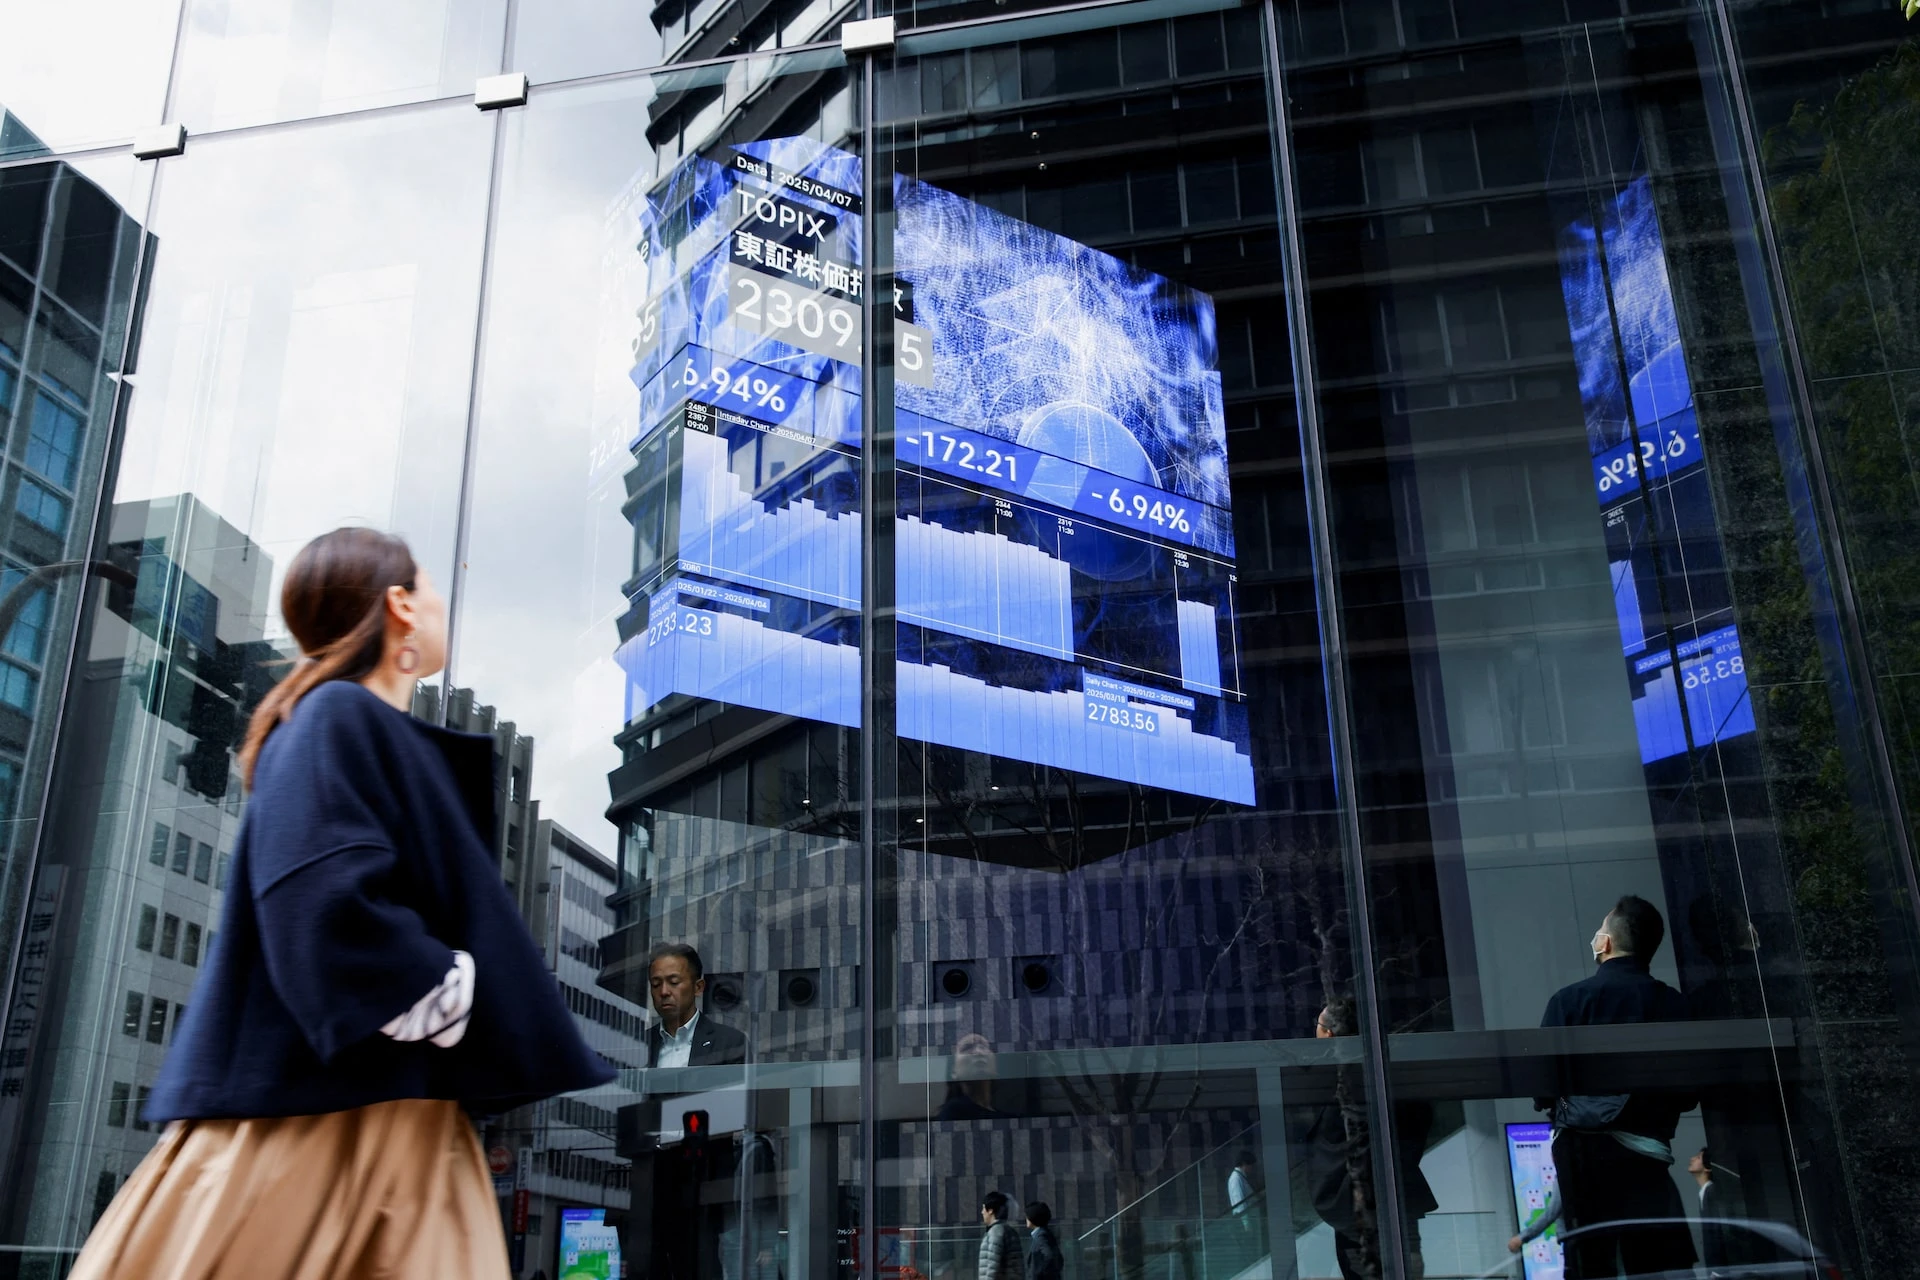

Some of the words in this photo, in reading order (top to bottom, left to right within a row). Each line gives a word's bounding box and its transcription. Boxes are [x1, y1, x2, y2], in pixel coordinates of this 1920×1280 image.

[737, 156, 767, 177] Data
[779, 172, 852, 207] 2025/04/07
[736, 189, 826, 242] TOPIX
[735, 278, 923, 371] 2309.5
[672, 358, 786, 412] -6.94%
[688, 402, 708, 414] 2480
[688, 411, 707, 423] 2387
[719, 411, 749, 427] Intraday
[750, 420, 770, 431] Chart
[687, 419, 709, 432] 09:00
[906, 431, 1016, 482] -172.21
[1091, 487, 1190, 534] -6.94%
[996, 508, 1013, 518] 11:00
[649, 611, 712, 647] 2733.23
[1101, 680, 1118, 690] Chart
[1088, 702, 1155, 732] 2783.56
